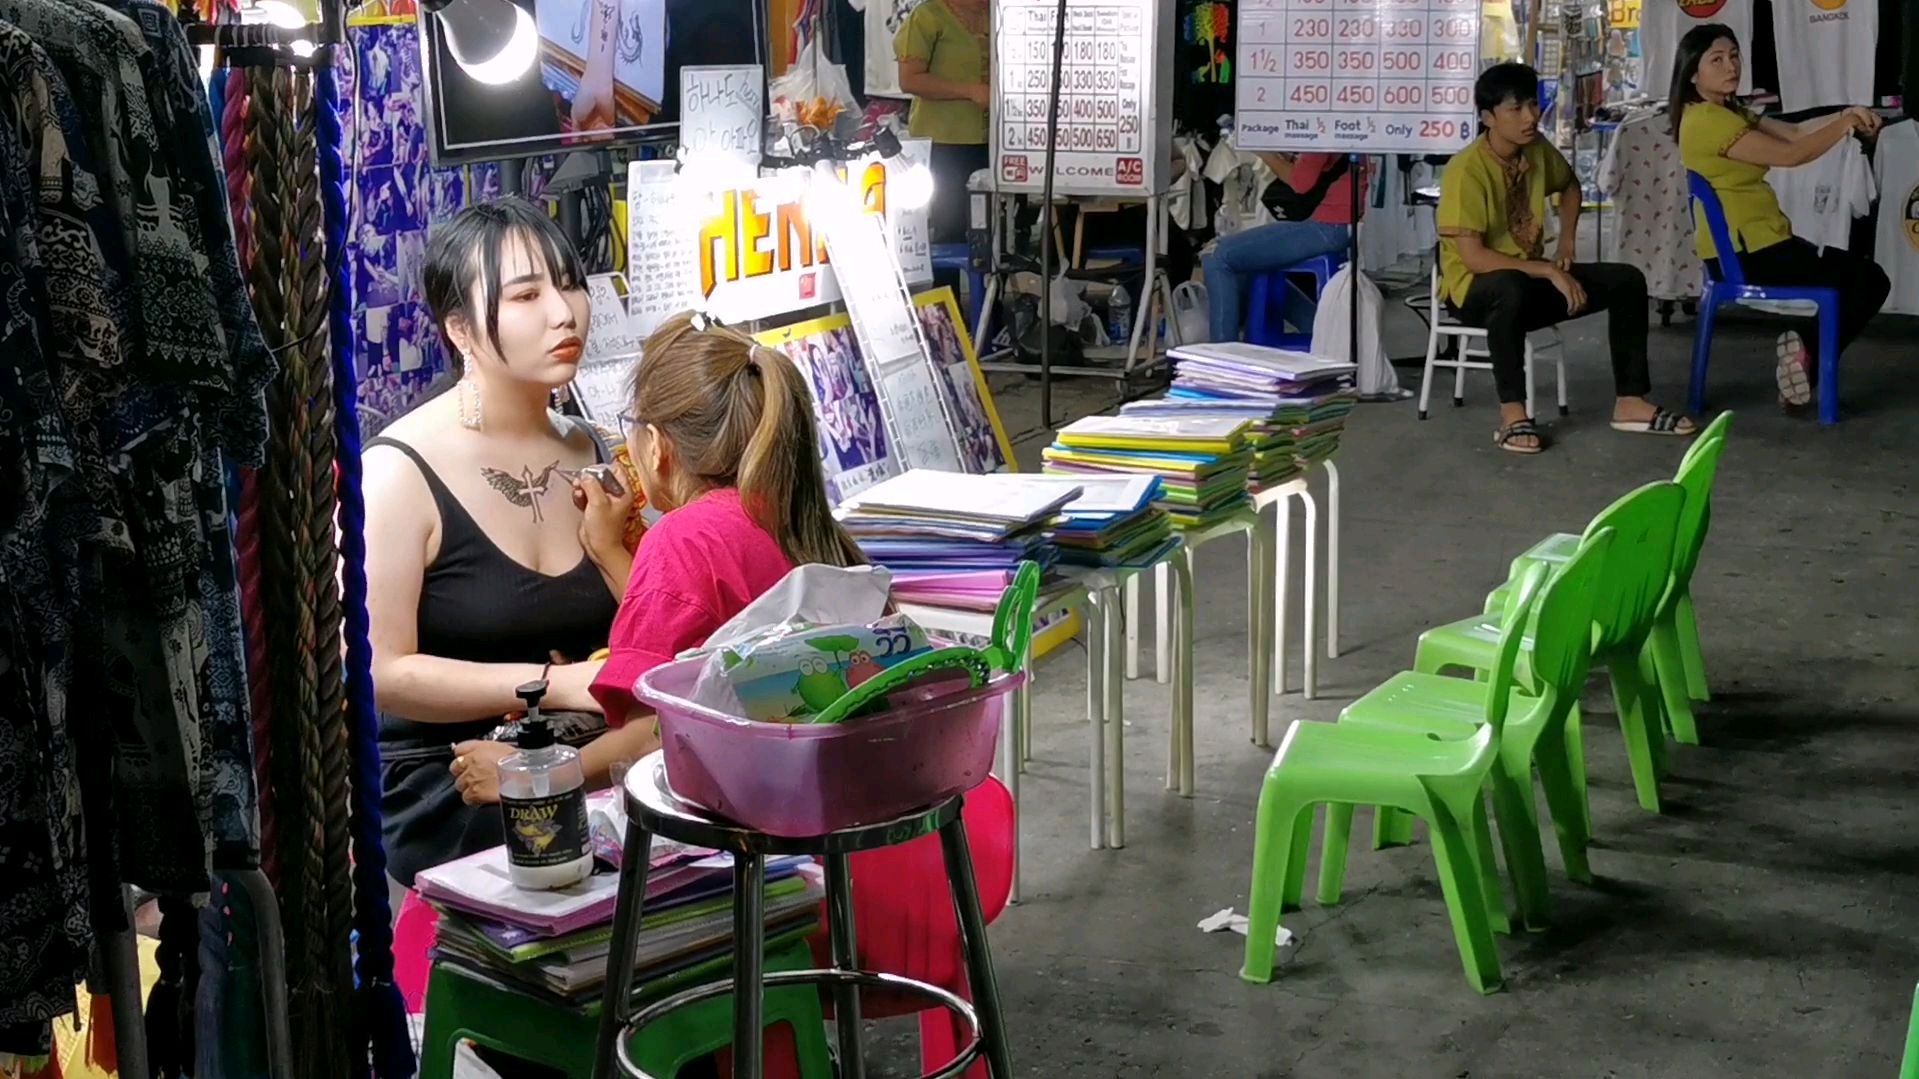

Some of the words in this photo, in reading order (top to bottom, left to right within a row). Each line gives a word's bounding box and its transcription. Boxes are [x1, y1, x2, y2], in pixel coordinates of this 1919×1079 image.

[1293, 19, 1330, 38] 230
[1338, 19, 1374, 38] 230
[1385, 19, 1422, 38] 330
[1433, 19, 1470, 38] 300
[1027, 42, 1046, 60] 150
[1073, 42, 1093, 60] 180
[1097, 42, 1116, 60] 180
[1293, 51, 1330, 70] 350
[1338, 51, 1374, 70] 350
[1383, 51, 1421, 70] 500
[1433, 51, 1471, 70] 400
[1027, 70, 1046, 88] 250
[1073, 70, 1093, 89] 330
[1097, 71, 1116, 89] 350
[1257, 87, 1266, 102] 2
[1290, 86, 1328, 104] 450
[1336, 86, 1375, 104] 450
[1384, 86, 1422, 105] 600
[1432, 86, 1469, 105] 500
[1026, 99, 1046, 118] 350
[1073, 101, 1093, 119] 400
[1096, 101, 1116, 119] 500
[1119, 116, 1138, 134] 250
[1241, 123, 1279, 135] Package
[1285, 119, 1310, 131] Thai
[1334, 120, 1361, 132] Foot
[1385, 124, 1413, 138] Only
[1419, 120, 1455, 138] 250
[1027, 127, 1047, 146] 450
[1073, 129, 1093, 148] 500
[1096, 129, 1116, 148] 650
[1029, 166, 1114, 177] WLCOME
[1117, 160, 1141, 173] A/C
[699, 162, 887, 301] HENA
[509, 803, 559, 820] DRAW
